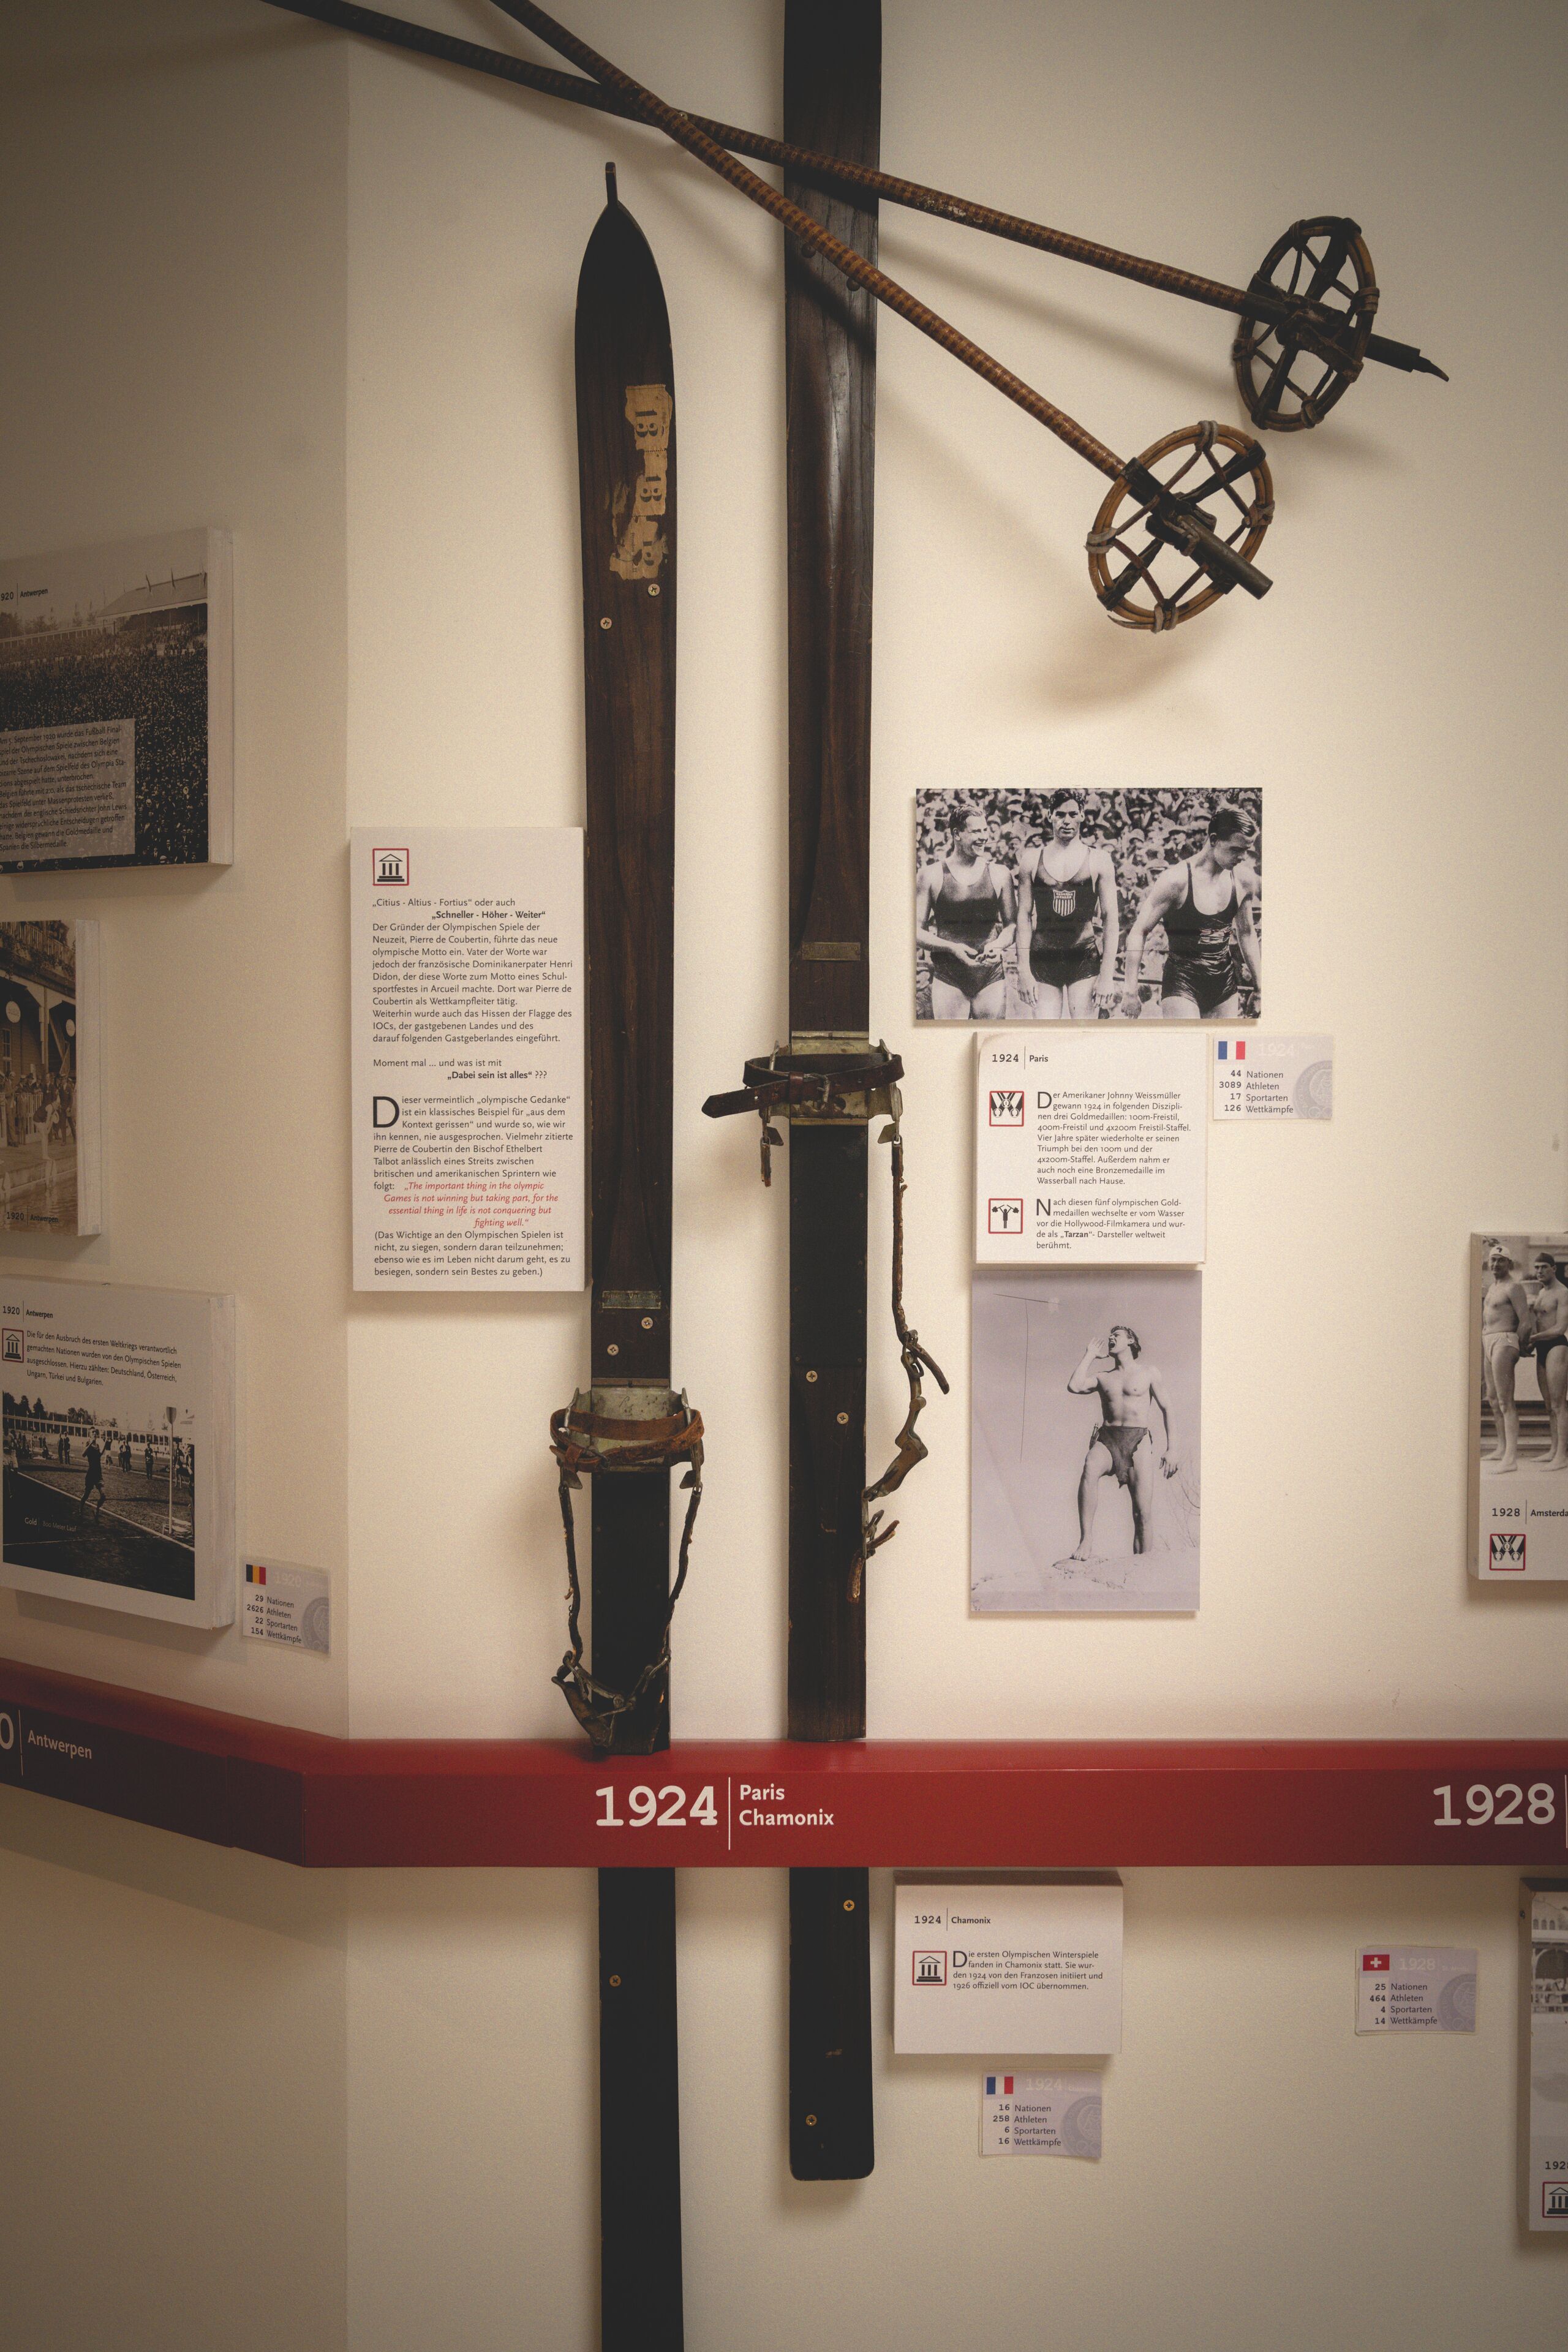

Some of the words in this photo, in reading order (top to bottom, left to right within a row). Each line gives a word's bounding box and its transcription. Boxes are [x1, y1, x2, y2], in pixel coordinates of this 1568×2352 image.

[20, 589, 48, 597] Antwerpen
[390, 922, 425, 931] Gründer
[426, 922, 440, 931] der
[442, 922, 497, 933] Olympischen
[499, 922, 524, 933] Spiele
[526, 922, 540, 931] der
[372, 935, 407, 944] Neuzeit,
[435, 935, 447, 944] de
[448, 935, 491, 944] Coubertin,
[494, 935, 519, 943] führte
[520, 935, 535, 943] das
[992, 1054, 1019, 1063] 1924
[1029, 1054, 1049, 1063] Paris
[478, 1071, 495, 1079] sein
[497, 1071, 508, 1079] ist
[1245, 1082, 1280, 1090] Athleten
[1107, 1091, 1134, 1101] Johnny
[1134, 1091, 1181, 1099] Weissmüller
[1245, 1093, 1288, 1103] Sportarten
[1245, 1104, 1294, 1115] Wettkämpfe
[1037, 1144, 1069, 1154] Triumph
[1124, 1144, 1139, 1153] und
[1036, 1176, 1077, 1185] Wasserball
[6, 1212, 25, 1221] 1920
[473, 1218, 505, 1229] fighting
[1097, 1230, 1134, 1238] Darsteller
[1134, 1230, 1166, 1238] weltweit
[1036, 1240, 1072, 1249] berühmt.
[2, 1305, 20, 1314] 1920
[26, 1309, 53, 1319] Antwerpen
[55, 1333, 81, 1343] Ausbruch
[110, 1340, 138, 1351] Weltkriegs
[138, 1345, 177, 1354] verantwortlich
[56, 1346, 80, 1355] Nationen
[124, 1355, 160, 1366] Olympischen
[161, 1359, 181, 1368] Spielen
[26, 1358, 69, 1367] ausgeschlossen.
[110, 1366, 146, 1378] Deutschland,
[146, 1371, 177, 1382] Österreich,
[26, 1370, 48, 1379] Ungarn,
[48, 1371, 64, 1380] Türkei
[77, 1375, 103, 1385] Bulgarien.
[1491, 1507, 1520, 1517] 1928
[266, 1596, 295, 1608] Nationen
[246, 1604, 264, 1613] 2626
[266, 1607, 292, 1618] Athleten
[266, 1618, 298, 1631] Sportarten
[266, 1630, 302, 1644] Wettkämpfe
[28, 1729, 92, 1760] Antwerpen
[595, 1785, 718, 1827] 1924
[740, 1783, 785, 1801] Paris
[1433, 1782, 1556, 1826] 1928
[739, 1808, 834, 1826] Chamonix
[914, 1915, 941, 1924] 1924
[1001, 1950, 1050, 1960] Olympischen
[1052, 1950, 1099, 1960] Winterspiele
[968, 1960, 993, 1969] fanden
[1398, 1958, 1436, 1971] 1928
[952, 1970, 967, 1979] den
[953, 1981, 971, 1991] 1926
[972, 1981, 999, 1989] offiziell
[1036, 1981, 1089, 1990] übernommen.
[1390, 1994, 1423, 2002] Athleten
[1390, 2005, 1433, 2015] Sportarten
[1390, 2016, 1438, 2027] Wettkämpfe
[1025, 2078, 1063, 2091] 1924
[1014, 2115, 1047, 2124] Athleten
[1014, 2127, 1056, 2136] Sportarten
[1014, 2137, 1061, 2147] Wettkämpfe
[1545, 2160, 1568, 2170] 192
